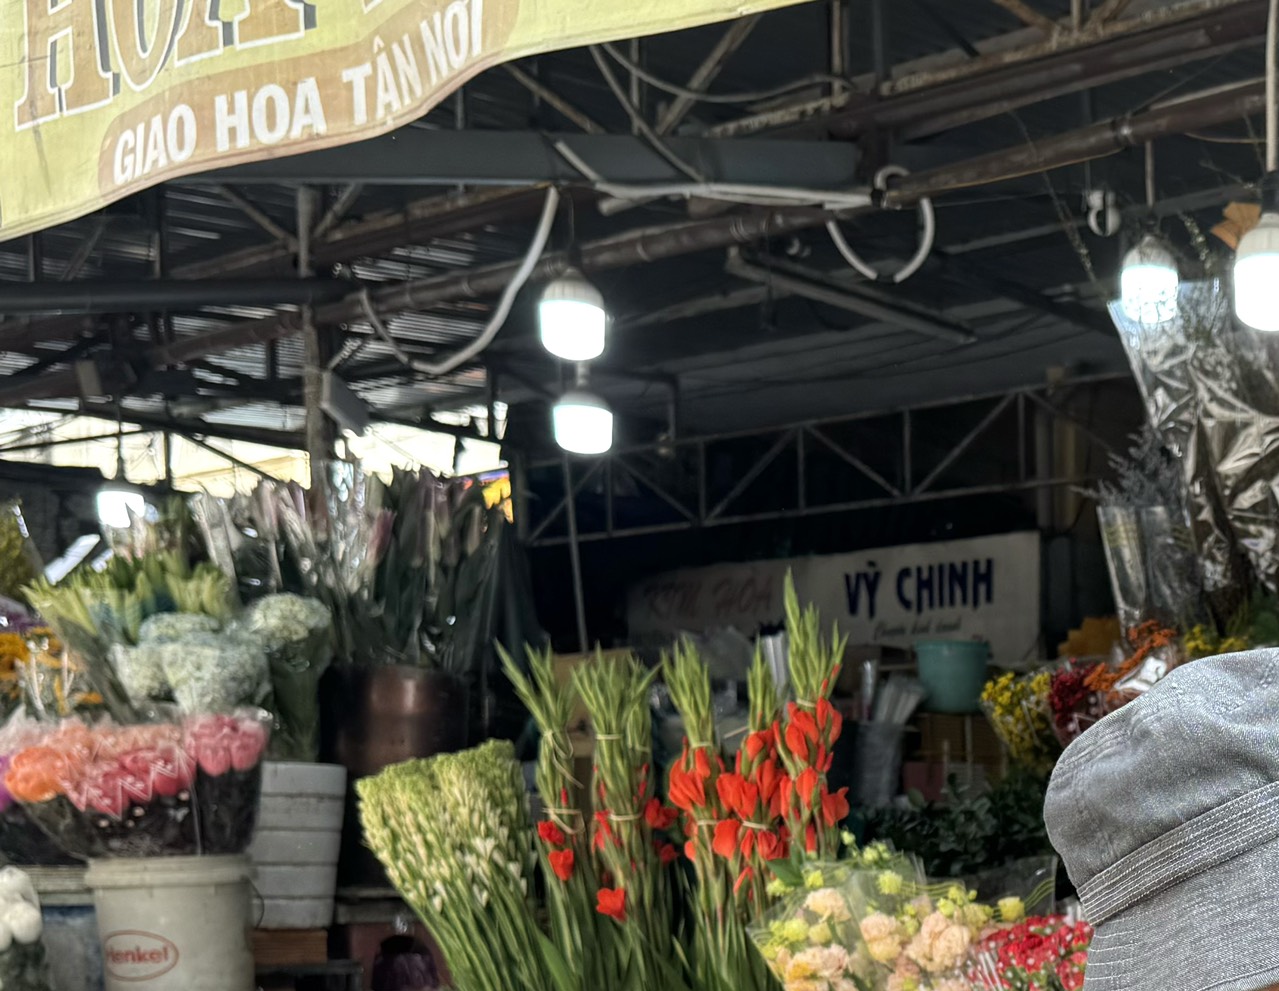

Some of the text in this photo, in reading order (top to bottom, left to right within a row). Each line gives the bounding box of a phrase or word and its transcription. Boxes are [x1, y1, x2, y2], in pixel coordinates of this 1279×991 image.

[15, 0, 308, 131] HO
[113, 103, 197, 186] GIAO
[214, 77, 327, 152] HOA
[896, 558, 993, 614] CHINH
